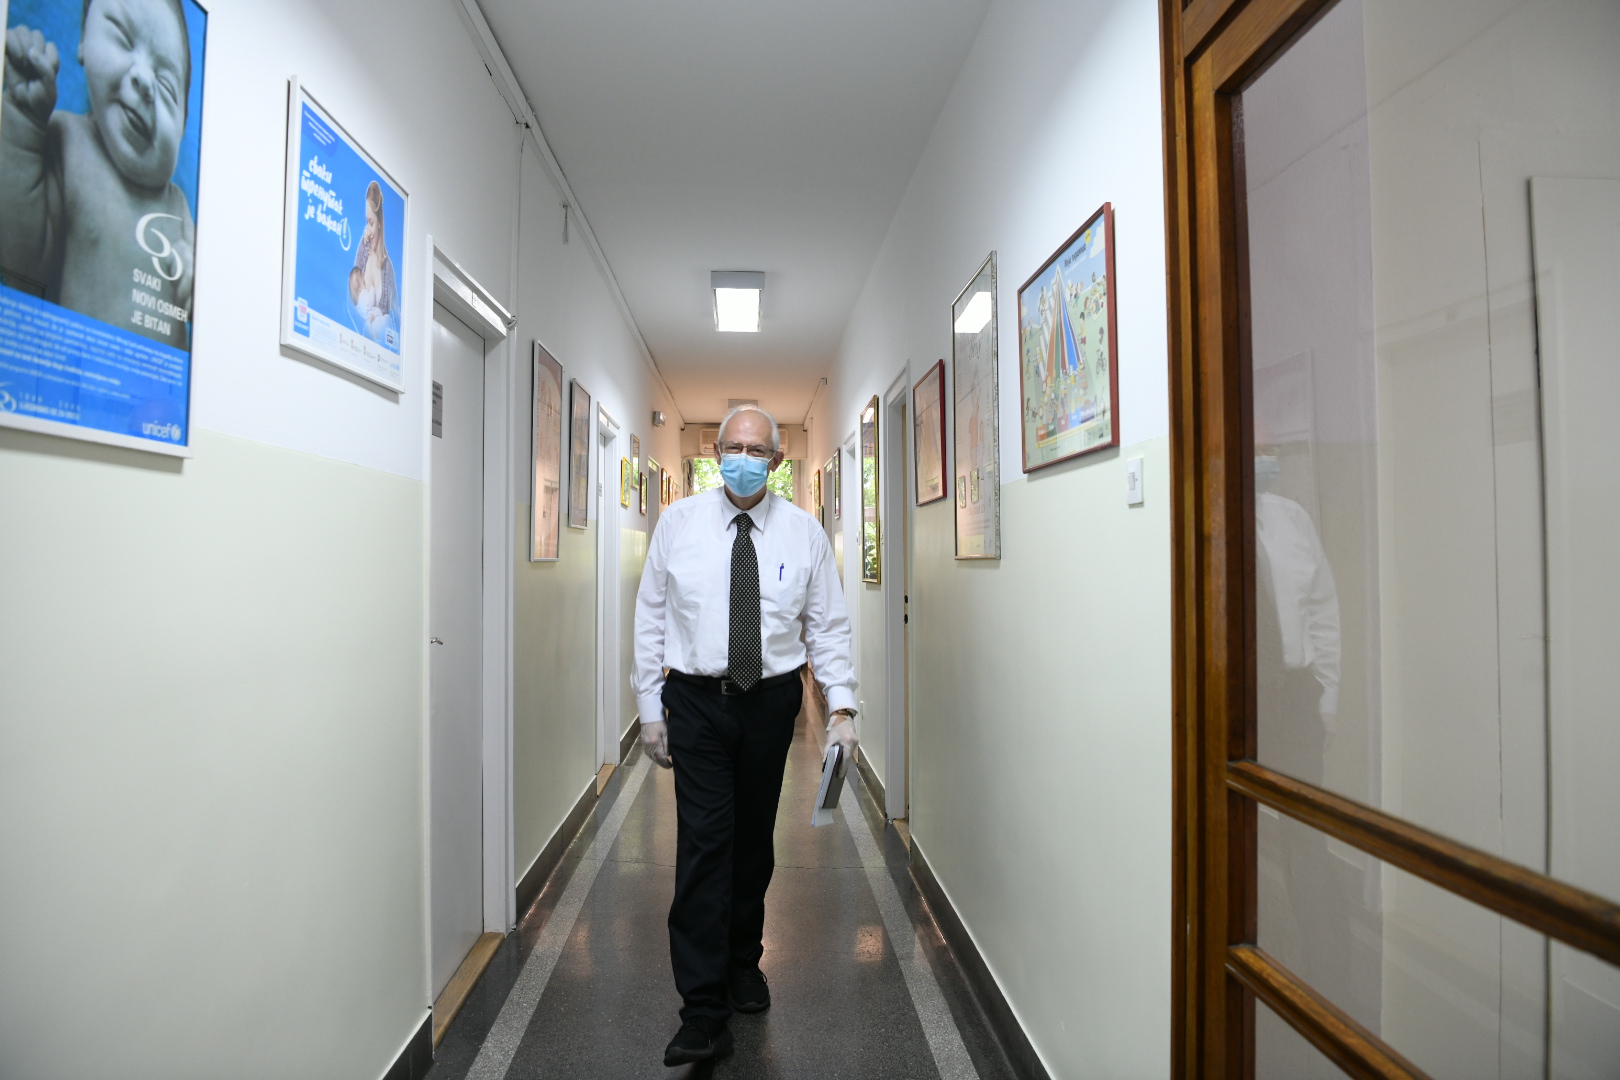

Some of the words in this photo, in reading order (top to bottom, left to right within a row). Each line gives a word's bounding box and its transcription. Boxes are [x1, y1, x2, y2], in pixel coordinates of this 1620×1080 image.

[308, 155, 333, 184] сваки
[304, 198, 315, 220] је
[132, 268, 162, 292] SVAKI
[131, 288, 157, 311] NOVI
[156, 299, 188, 323] OSMEH
[130, 310, 144, 326] JE
[143, 314, 172, 337] BITAN
[142, 420, 171, 440] unicef
